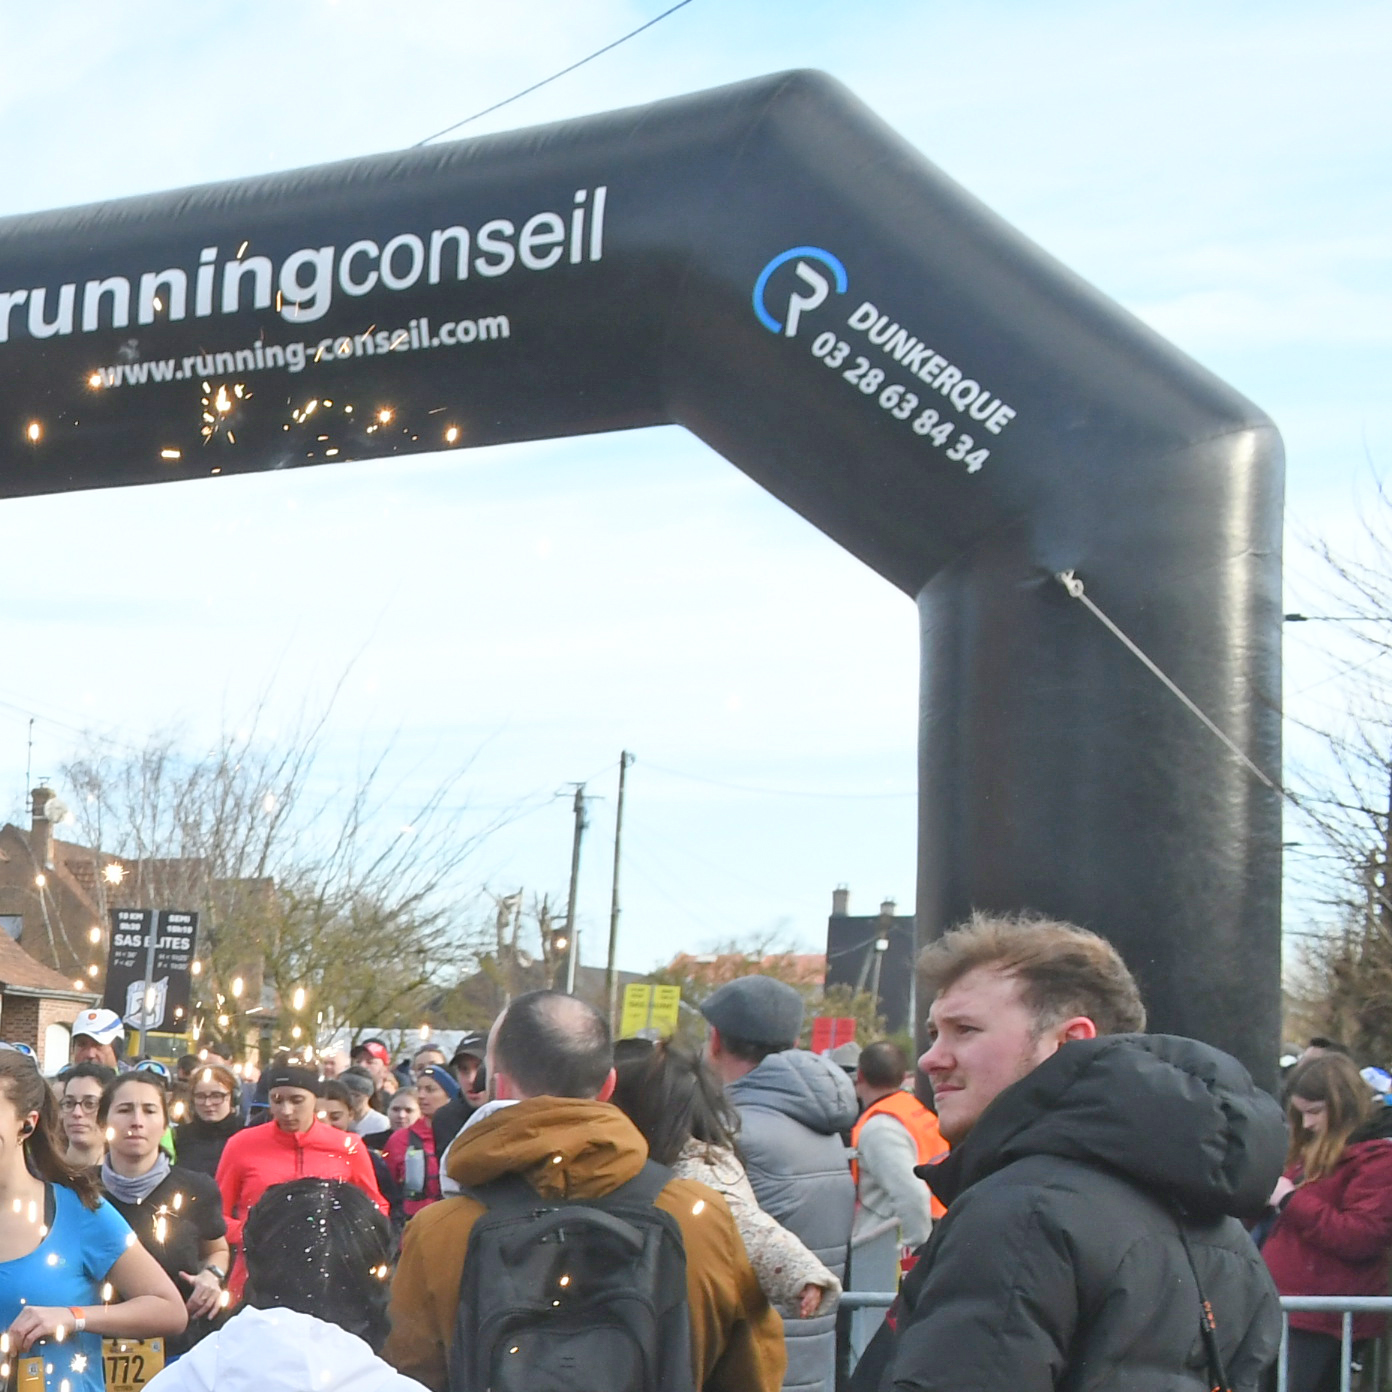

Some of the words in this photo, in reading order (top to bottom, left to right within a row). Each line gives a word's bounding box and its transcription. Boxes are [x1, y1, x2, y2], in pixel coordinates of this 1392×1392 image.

[100, 311, 510, 388] www.running-conseil.com
[847, 301, 1016, 435] DUNKERQUE
[811, 331, 851, 368] 03
[842, 356, 885, 395] 28
[879, 384, 918, 420] 63
[912, 408, 955, 447] 84
[946, 434, 990, 474] 34
[114, 933, 142, 947] SAS
